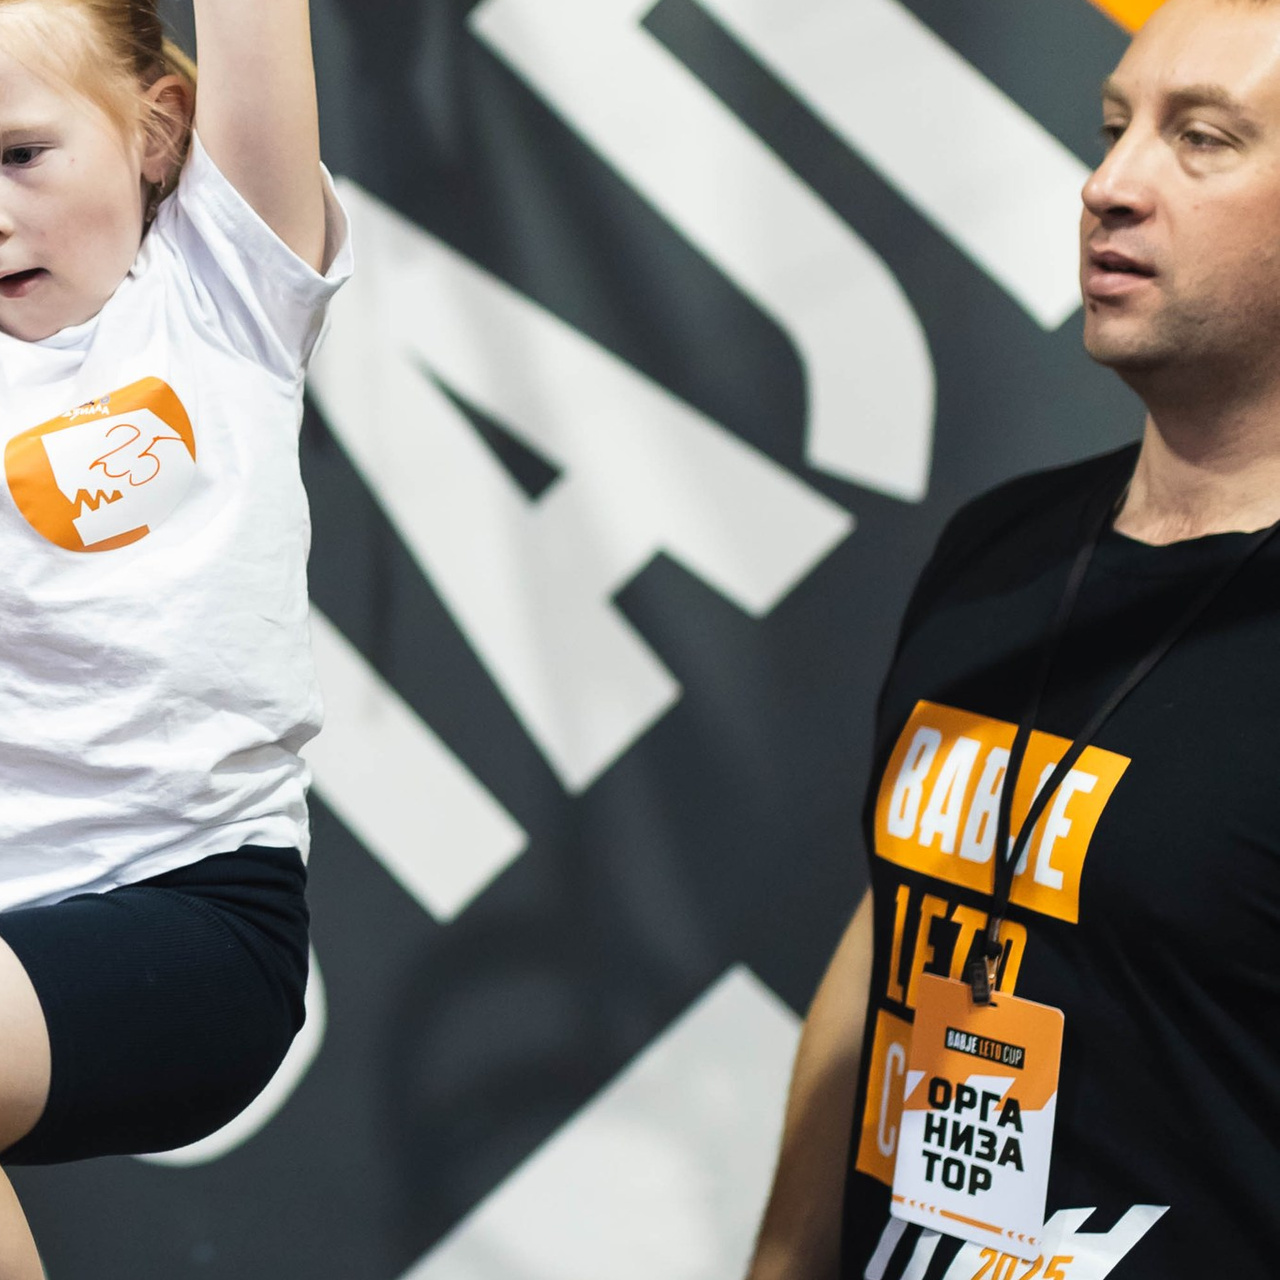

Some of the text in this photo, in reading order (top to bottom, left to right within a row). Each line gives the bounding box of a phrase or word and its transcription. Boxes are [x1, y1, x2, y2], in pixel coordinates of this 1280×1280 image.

[979, 1040, 1002, 1060] LETO
[1003, 1045, 1022, 1065] CUP
[928, 1076, 1024, 1133] ОРГА
[923, 1113, 1024, 1172] НИЗА
[922, 1150, 992, 1196] ТОР
